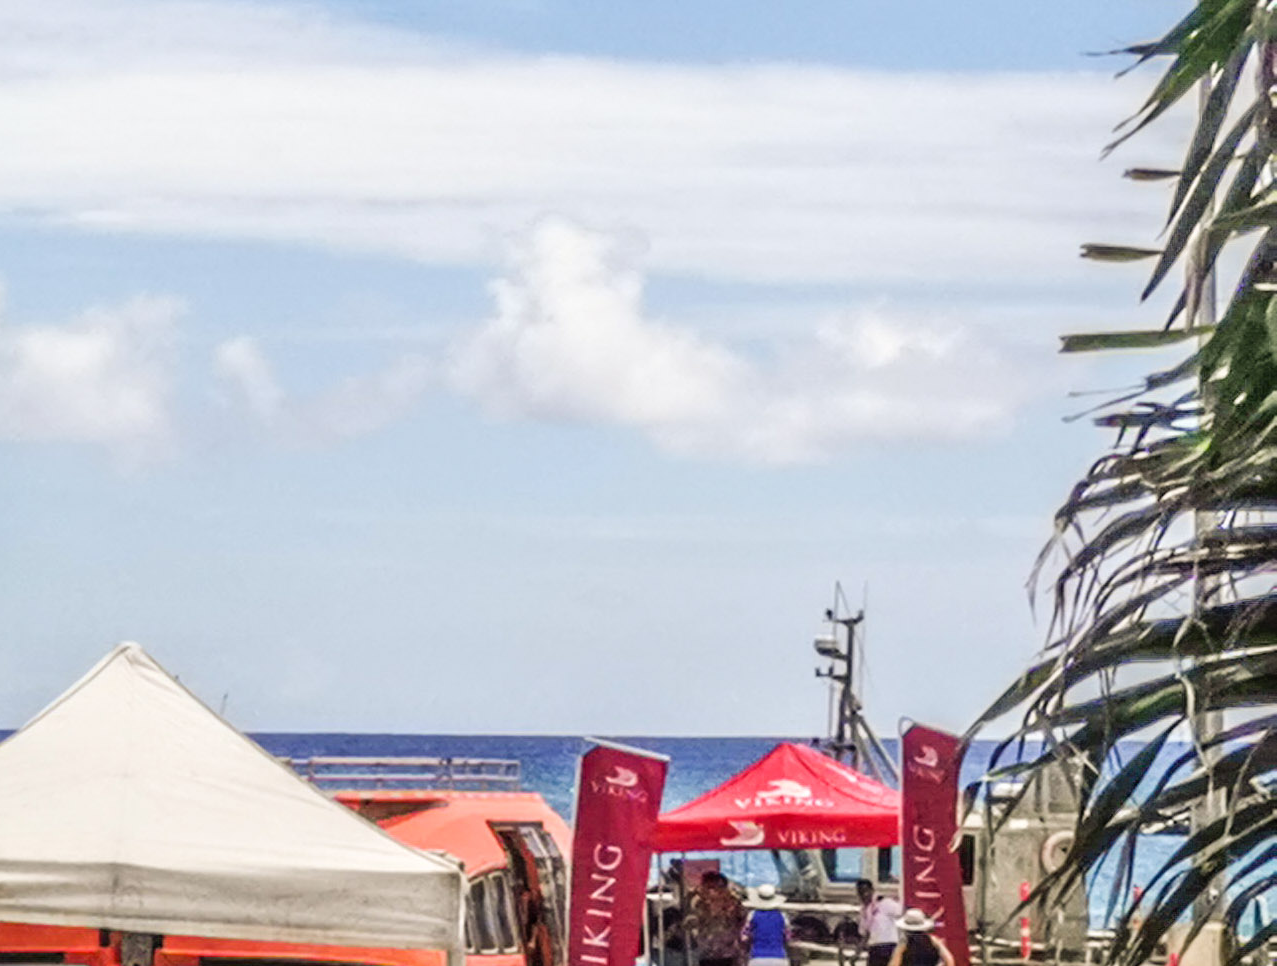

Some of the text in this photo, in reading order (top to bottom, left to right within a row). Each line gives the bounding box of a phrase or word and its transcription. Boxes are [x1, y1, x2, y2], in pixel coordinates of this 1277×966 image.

[591, 780, 648, 804] VIKING
[734, 797, 834, 809] VIKING
[777, 828, 846, 844] VIKING
